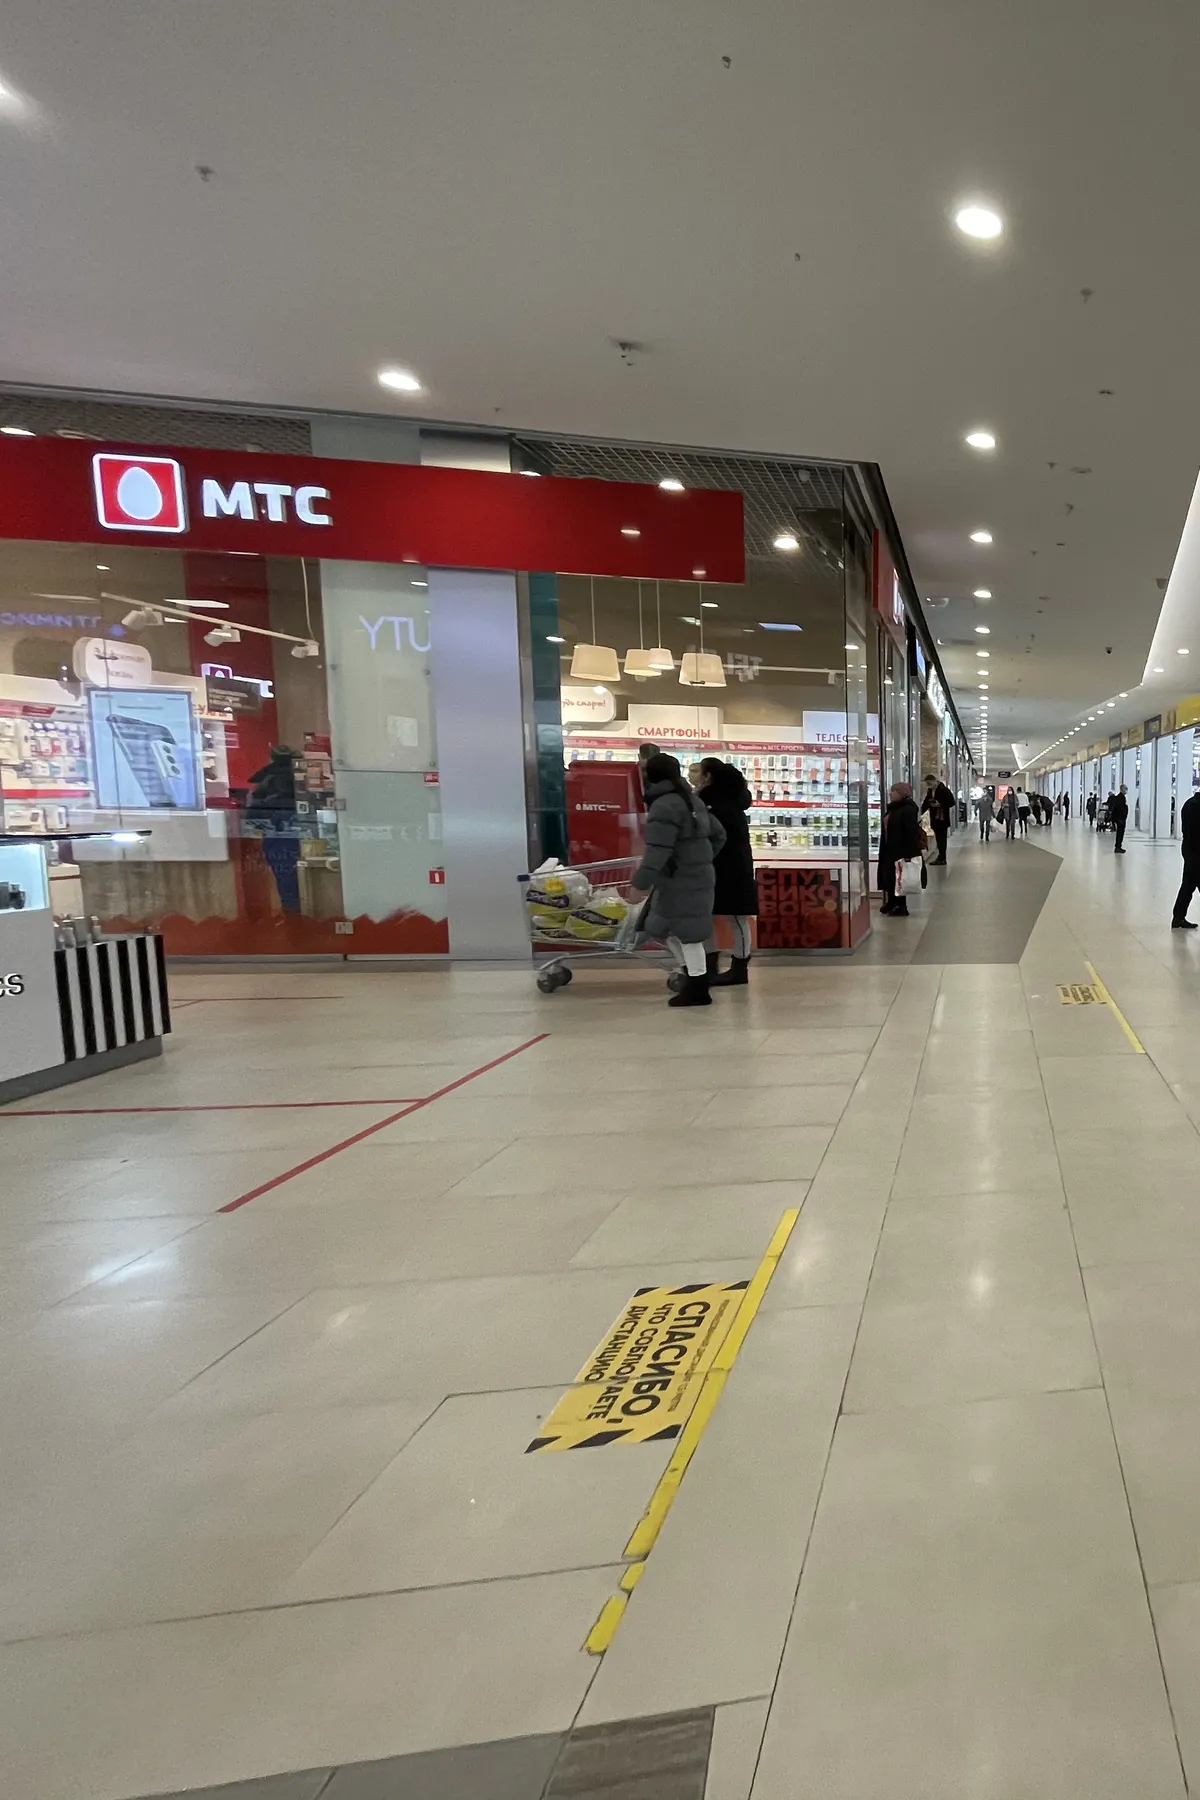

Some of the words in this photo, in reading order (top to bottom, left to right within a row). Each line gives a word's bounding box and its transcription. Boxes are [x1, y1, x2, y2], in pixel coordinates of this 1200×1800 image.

[203, 479, 333, 526] МТС
[637, 726, 711, 738] СМАРТФОНЫ
[815, 733, 875, 744] ТЕЛЕЫ
[582, 803, 606, 811] МТС
[648, 1303, 675, 1325] ЧТО
[584, 1305, 648, 1382] ДИСТАНЦИЮ
[586, 1328, 658, 1421] СОБЛЮДАЕТЕ
